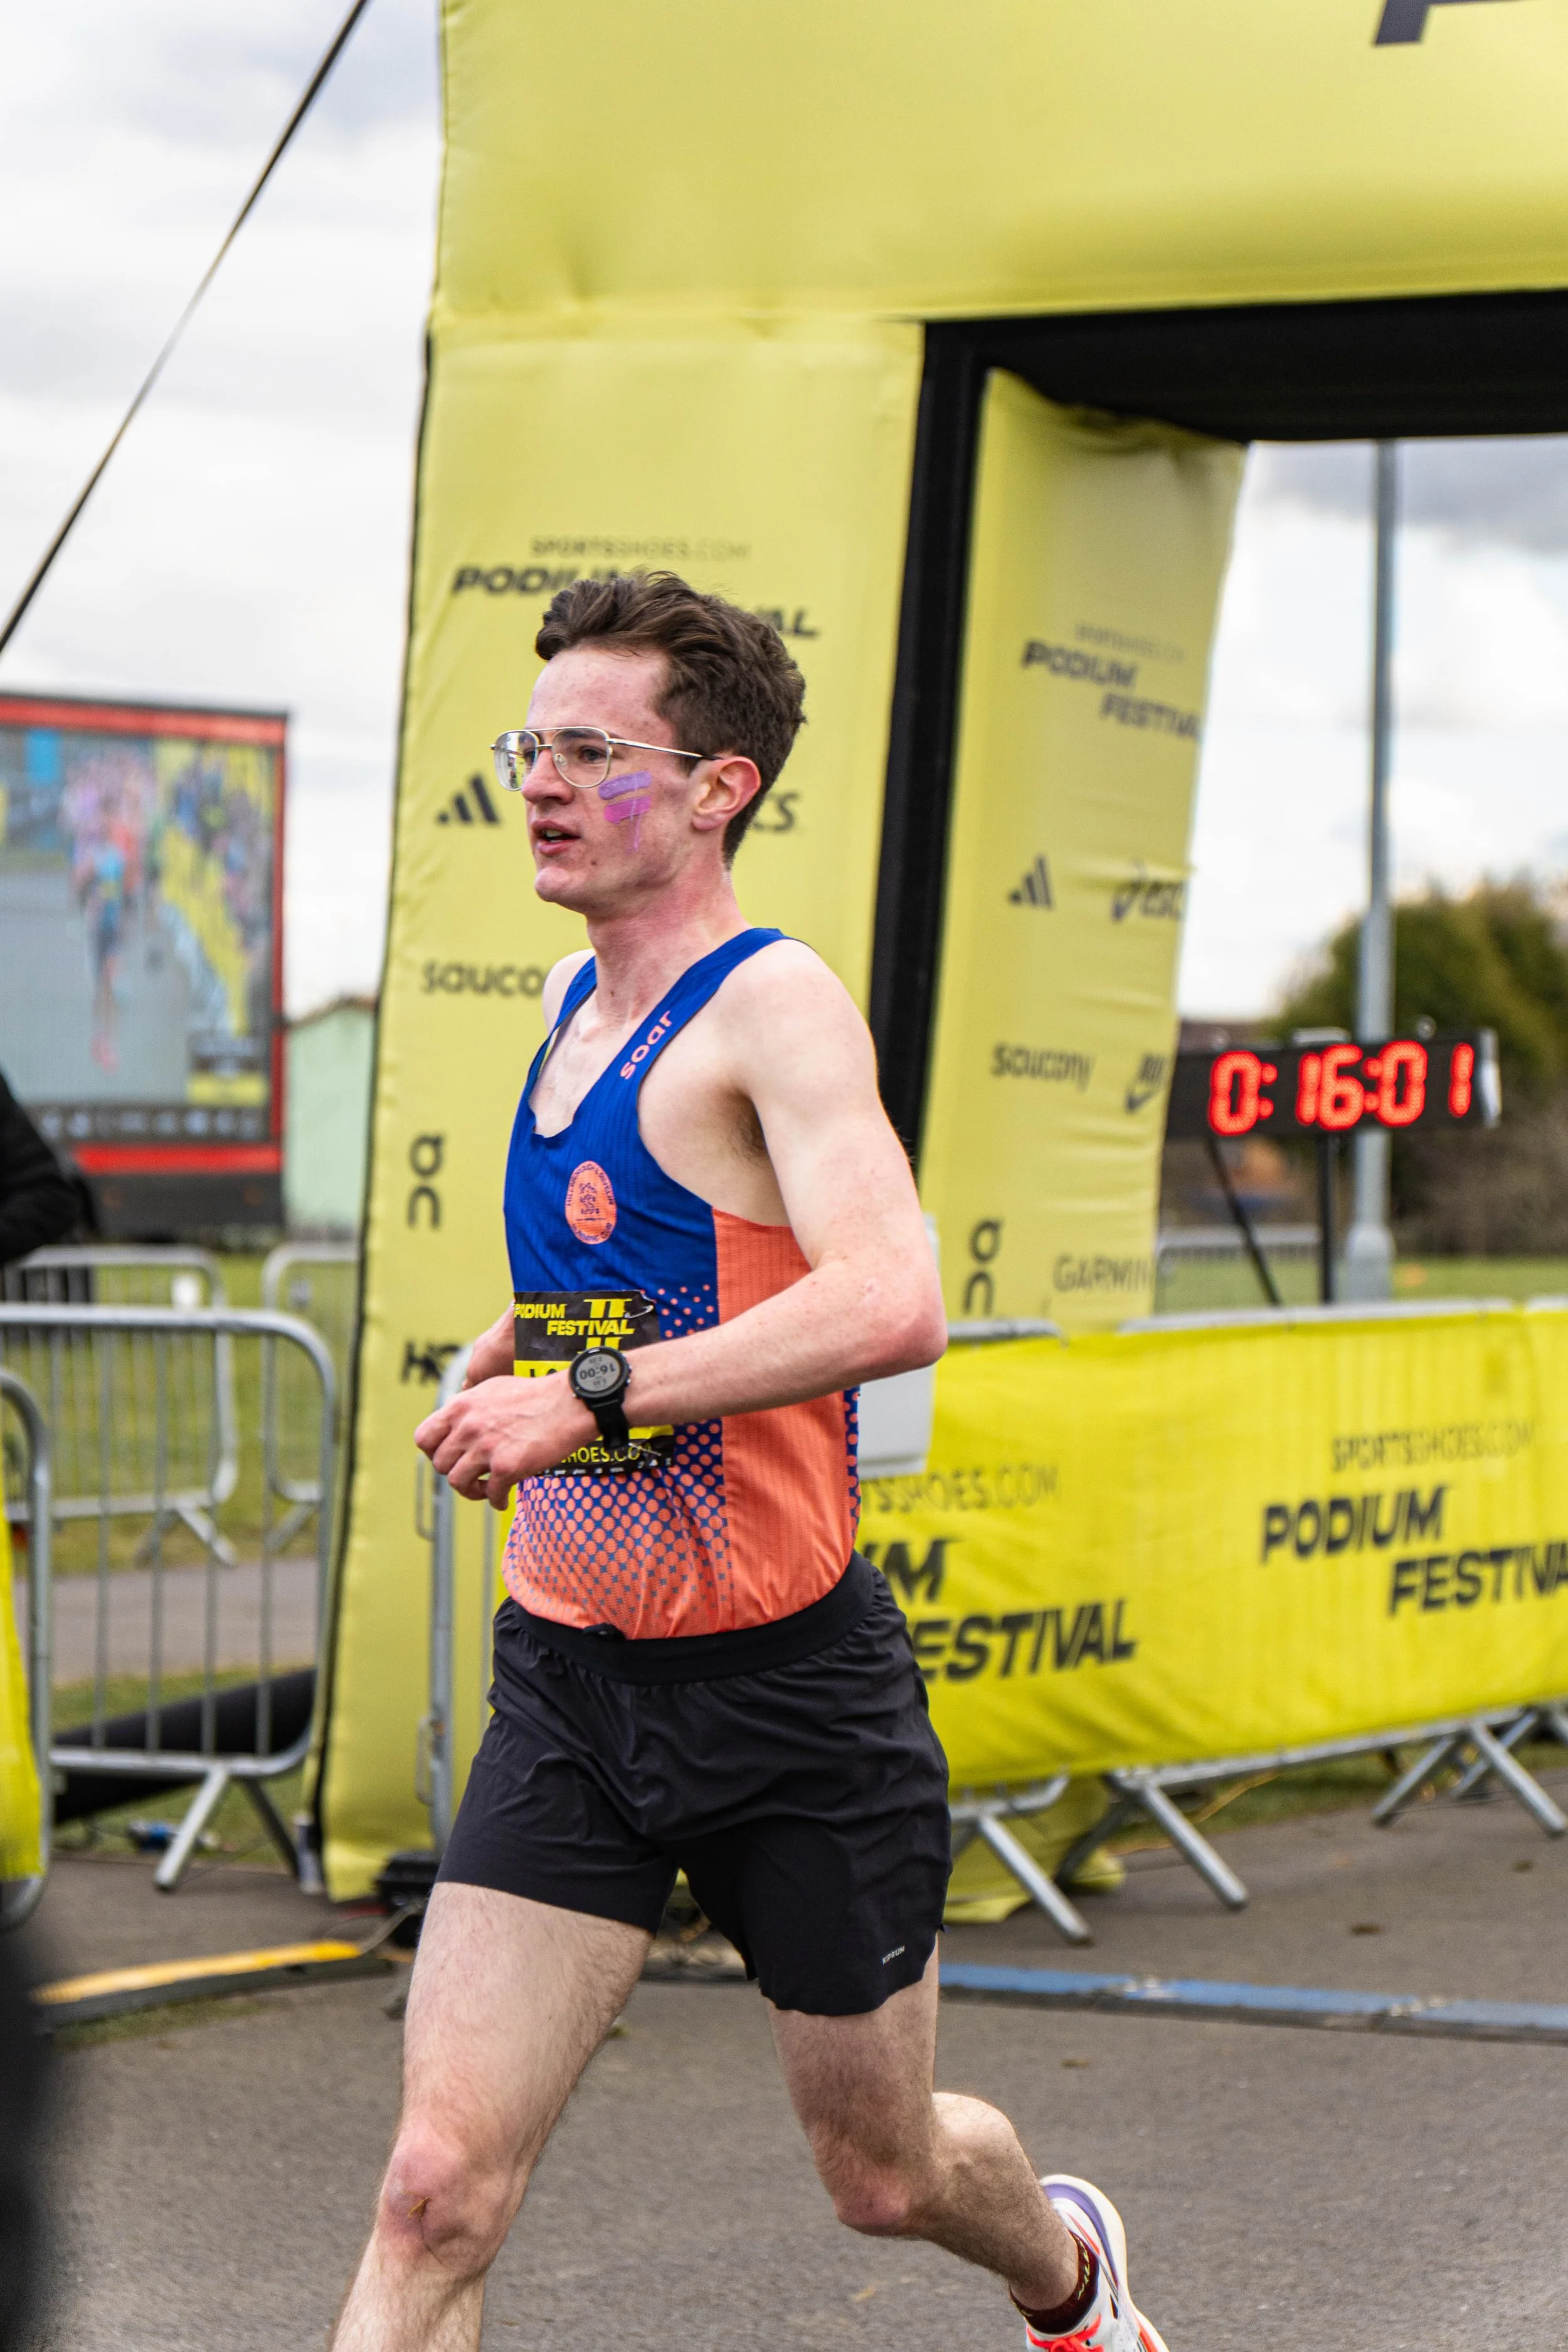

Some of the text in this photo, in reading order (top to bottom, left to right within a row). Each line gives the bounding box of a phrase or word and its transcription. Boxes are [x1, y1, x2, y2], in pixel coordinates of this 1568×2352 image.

[421, 960, 544, 997] sauco
[620, 1010, 672, 1079] soar
[547, 1319, 635, 1336] FESTIVAL
[1261, 1486, 1450, 1564] PODIUM
[1388, 1540, 1568, 1616] FESTIVA
[911, 1599, 1139, 1683] ESTIVAL
